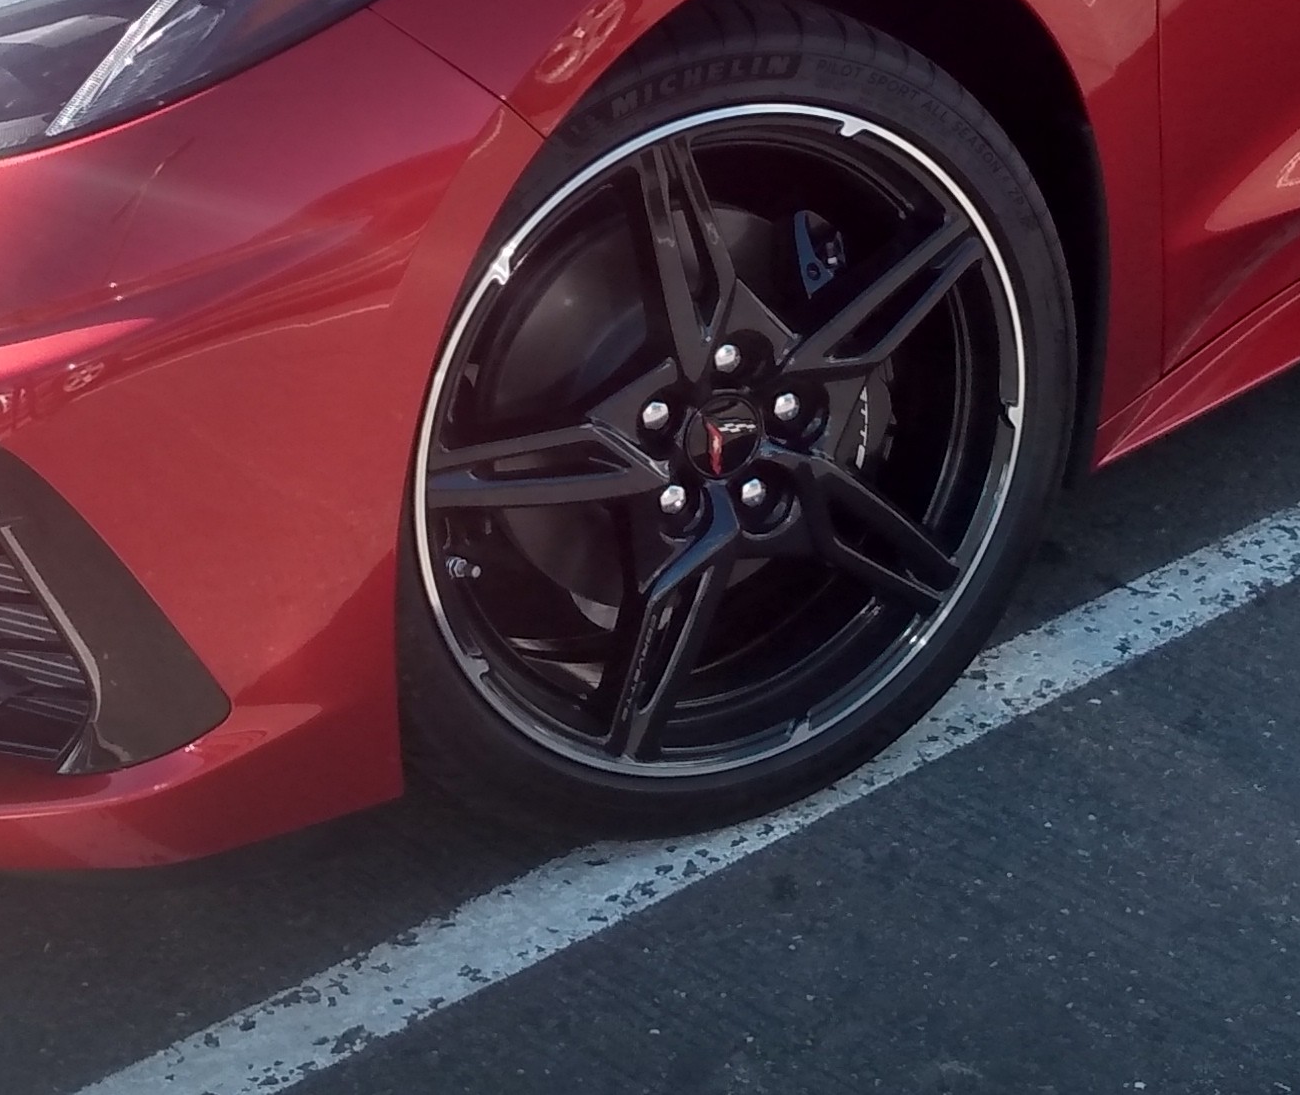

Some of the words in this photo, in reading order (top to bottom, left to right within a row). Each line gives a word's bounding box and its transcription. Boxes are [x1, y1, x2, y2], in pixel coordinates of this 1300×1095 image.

[610, 55, 791, 119] MICHELIN
[815, 58, 862, 79] PILOT
[867, 71, 922, 101] SPORT
[920, 99, 950, 122] ALL
[951, 118, 1004, 175] SEASON
